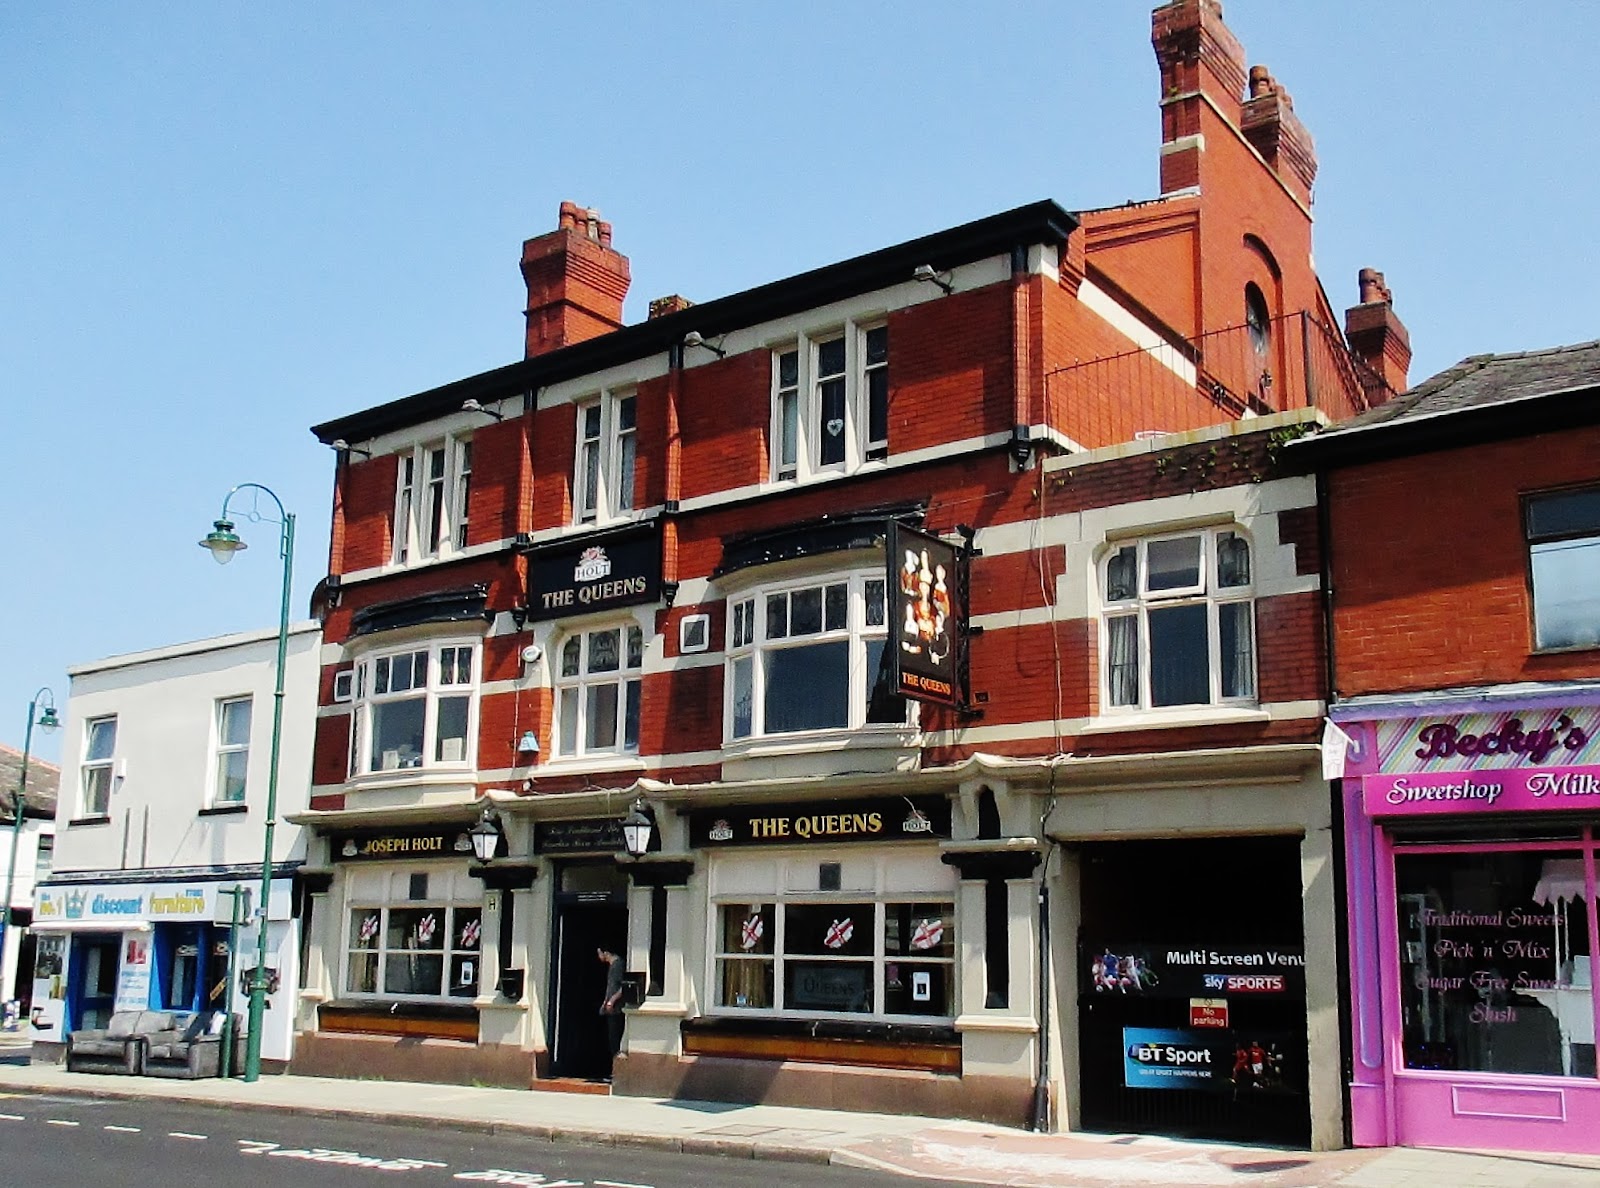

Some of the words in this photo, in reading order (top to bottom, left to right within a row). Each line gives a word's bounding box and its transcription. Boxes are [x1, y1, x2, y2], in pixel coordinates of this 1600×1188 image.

[576, 564, 609, 579] HOLT
[542, 588, 575, 609] THE
[578, 575, 647, 605] QUEENS
[901, 671, 919, 687] THE
[920, 675, 951, 696] QUEENS
[1415, 714, 1589, 764] Becky's
[1386, 778, 1502, 805] Sweetshop
[1526, 772, 1600, 797] Milk
[749, 817, 790, 838] THE
[795, 812, 883, 838] QUEENS
[364, 838, 409, 853] JOSEPH
[412, 836, 443, 851] HOLT
[92, 893, 143, 914] discount
[1418, 908, 1502, 926] Traditional
[1434, 939, 1473, 958] Pick
[1502, 939, 1550, 958] Mix
[1166, 950, 1206, 965] Multi
[1210, 951, 1264, 966] Screen
[1205, 976, 1224, 989] sky
[1228, 977, 1282, 990] SPORTS
[1202, 1007, 1215, 1016] No
[1469, 1002, 1517, 1023] Slush
[1193, 1017, 1224, 1027] parking
[1137, 1047, 1163, 1062] BT
[1165, 1047, 1211, 1065] Sport
